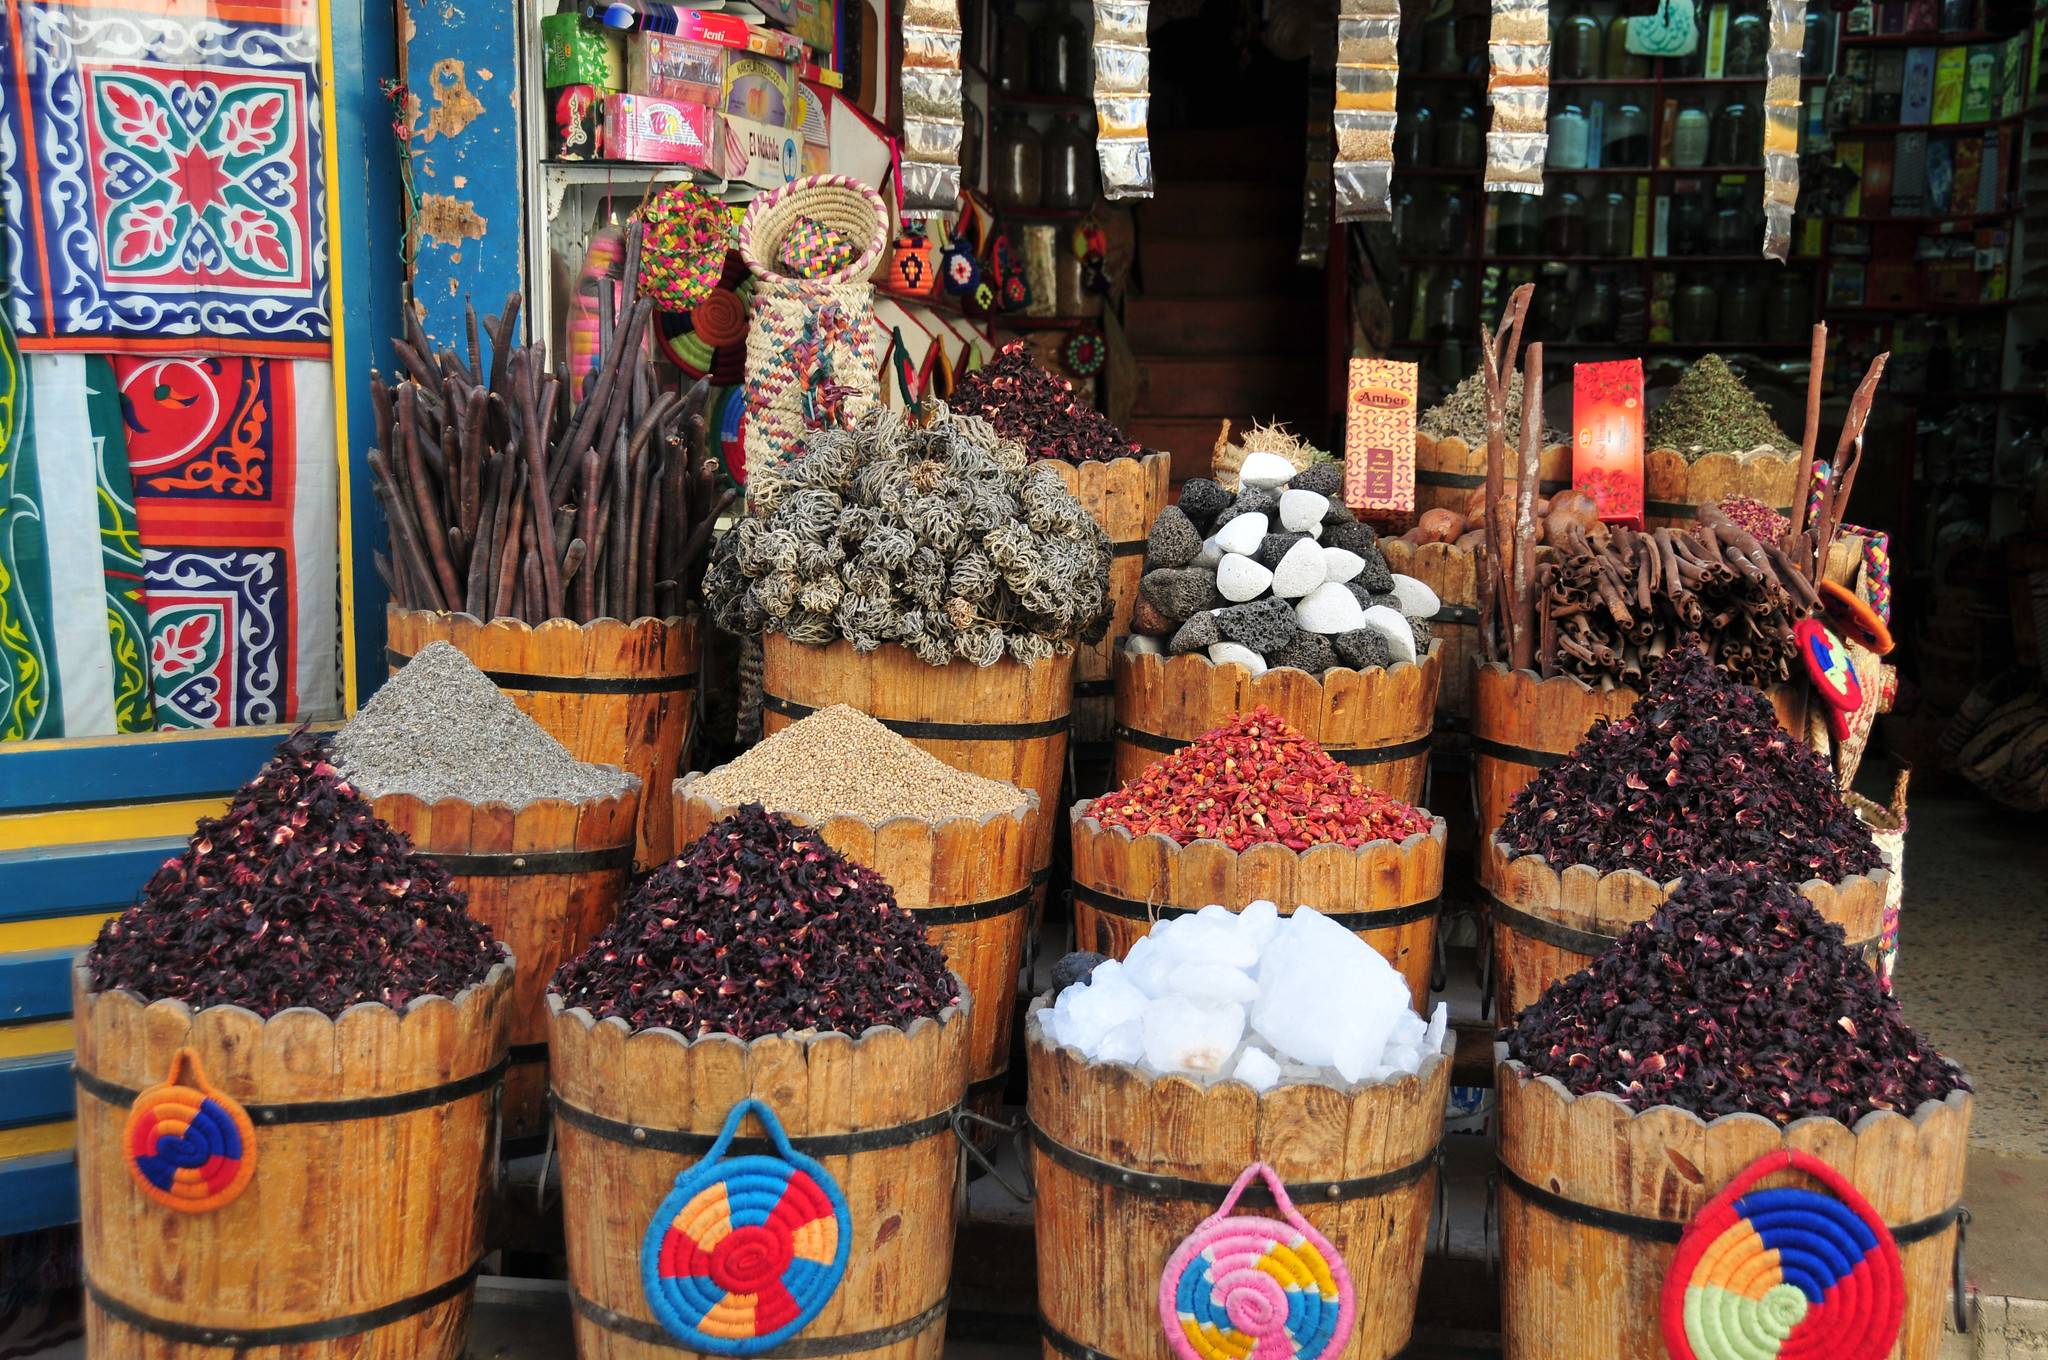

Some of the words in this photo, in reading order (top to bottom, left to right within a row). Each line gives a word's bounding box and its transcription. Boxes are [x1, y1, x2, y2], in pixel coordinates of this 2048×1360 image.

[703, 28, 726, 42] lenti
[749, 132, 756, 157] El
[1358, 391, 1407, 406] Amber
